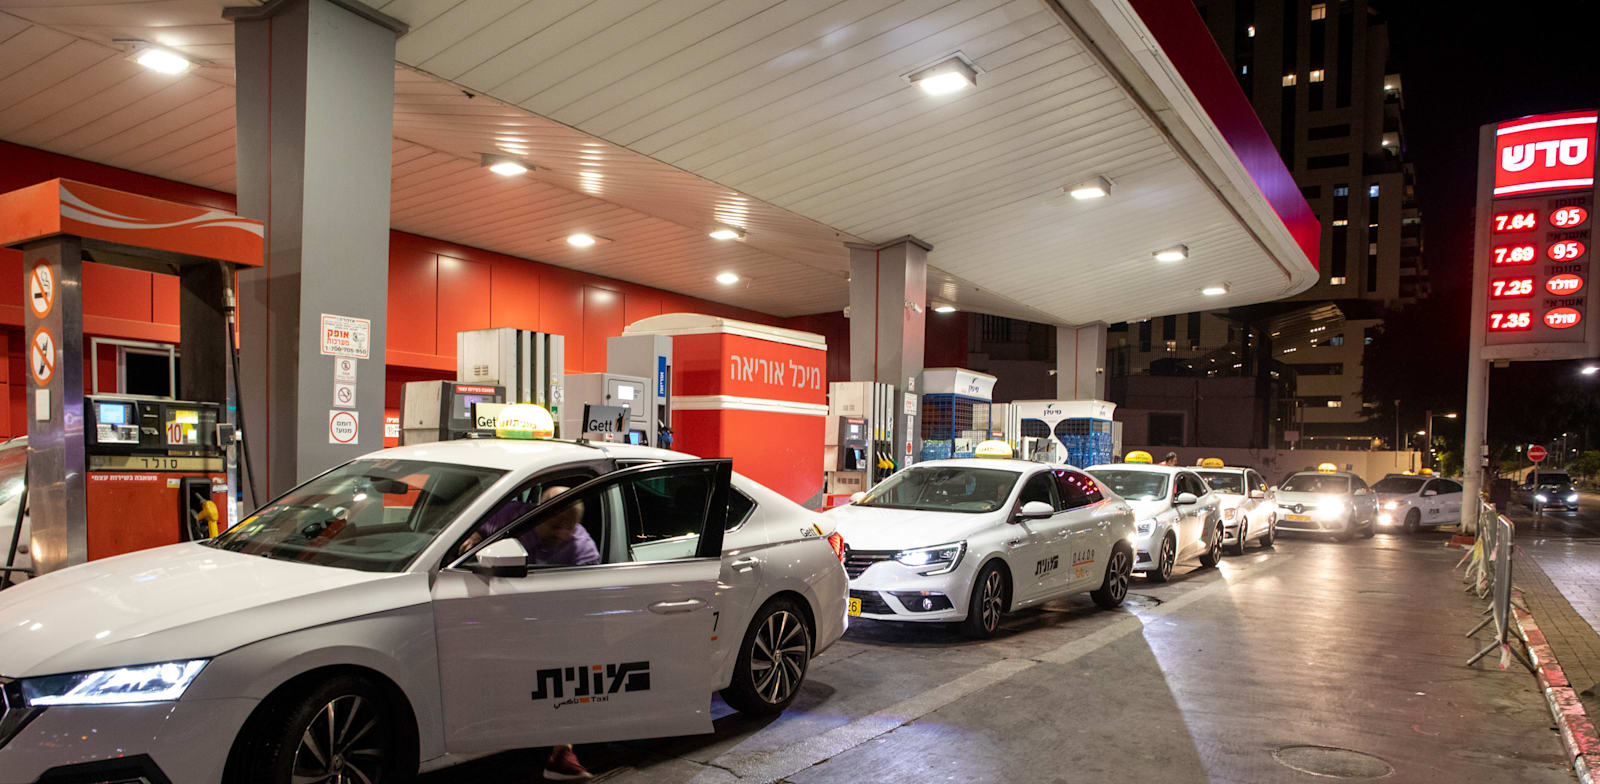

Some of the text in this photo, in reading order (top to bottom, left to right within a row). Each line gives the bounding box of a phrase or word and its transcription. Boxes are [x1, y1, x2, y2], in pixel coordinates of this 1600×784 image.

[1502, 137, 1588, 172] סדש
[1495, 212, 1535, 230] 7.64
[1555, 208, 1580, 226] 95
[1494, 246, 1535, 263] 7.69
[1553, 243, 1578, 259] 95
[1493, 279, 1533, 296] 7.25
[1548, 278, 1579, 290] סולר
[1490, 312, 1530, 328] 7.35
[1546, 313, 1577, 324] סולר
[327, 329, 349, 338] אופק
[730, 355, 820, 390] מיכל אוריאה
[477, 416, 497, 428] Get
[589, 419, 612, 432] Gett
[168, 424, 182, 443] 10
[141, 456, 178, 468] סולר
[800, 527, 818, 538] Gett
[531, 660, 651, 700] מונית
[590, 696, 609, 704] Taxi
